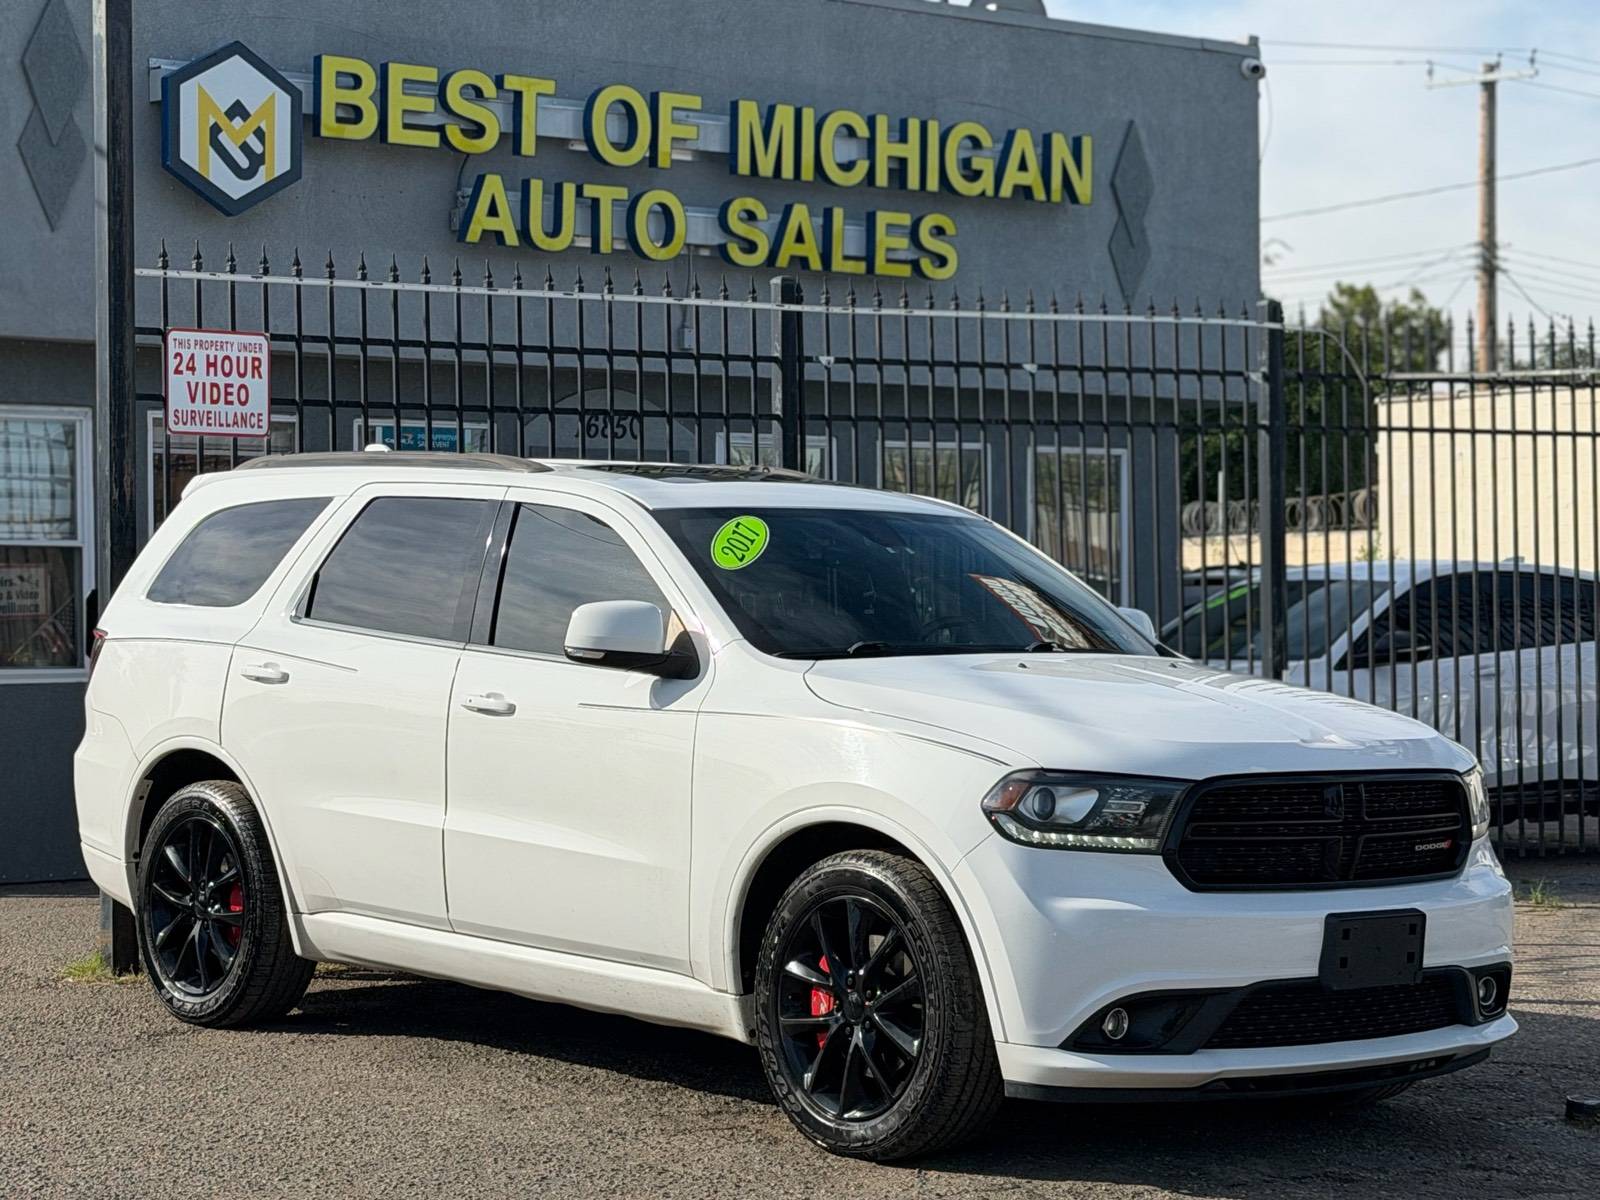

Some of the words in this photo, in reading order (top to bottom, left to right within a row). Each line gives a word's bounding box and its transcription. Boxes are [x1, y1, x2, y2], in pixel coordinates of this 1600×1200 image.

[315, 54, 556, 156] BEST
[585, 84, 702, 168] OF
[732, 99, 1093, 206] MICHIGAN
[459, 173, 687, 261] AUTO
[720, 197, 958, 281] SALES
[173, 338, 191, 350] THIS
[194, 339, 235, 352] PROPERTY
[237, 342, 263, 354] UNDER
[173, 352, 197, 376] 24
[205, 354, 263, 379] HOUR
[186, 381, 250, 406] VIDEO
[173, 409, 264, 429] SURVEILLANCE
[721, 521, 760, 562] 2017
[1415, 842, 1448, 851] DODGE
